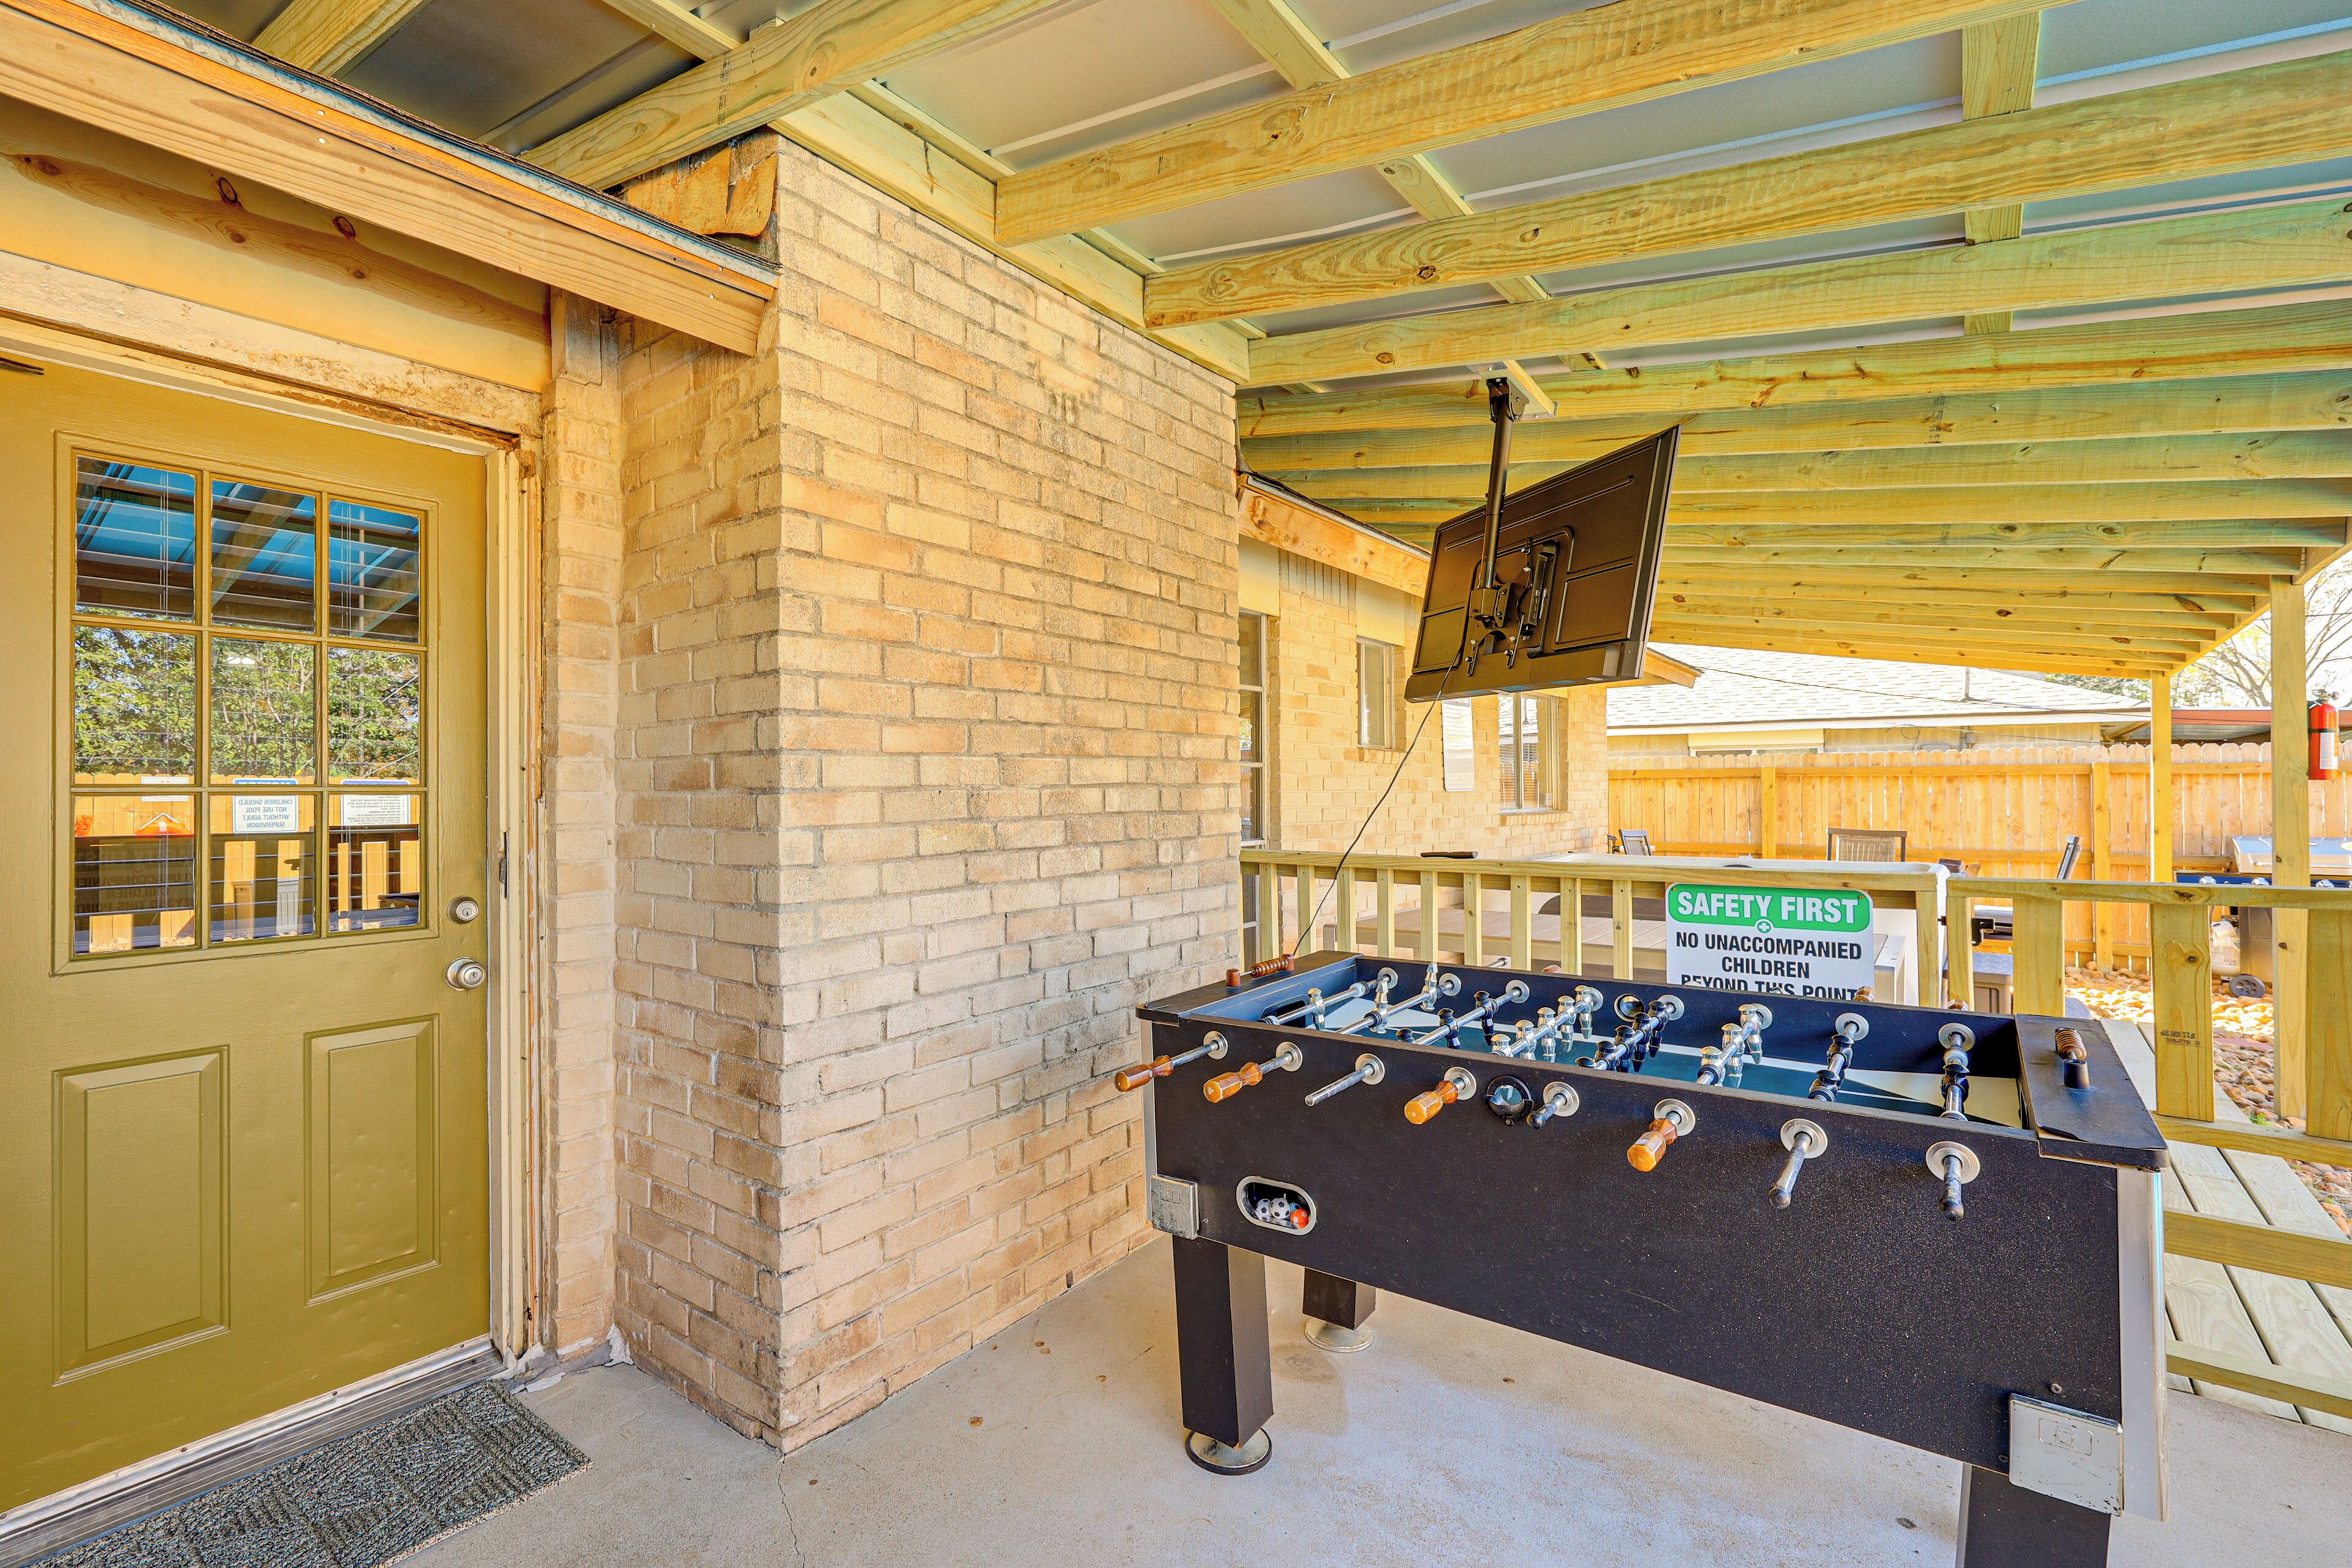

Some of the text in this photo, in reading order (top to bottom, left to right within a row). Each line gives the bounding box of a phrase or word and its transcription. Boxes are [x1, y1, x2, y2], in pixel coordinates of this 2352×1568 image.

[1678, 892, 1858, 924] SAFETY FIRST
[1676, 932, 1861, 960] NO UNACCOMPANIED
[1722, 956, 1810, 979] CHILDREN
